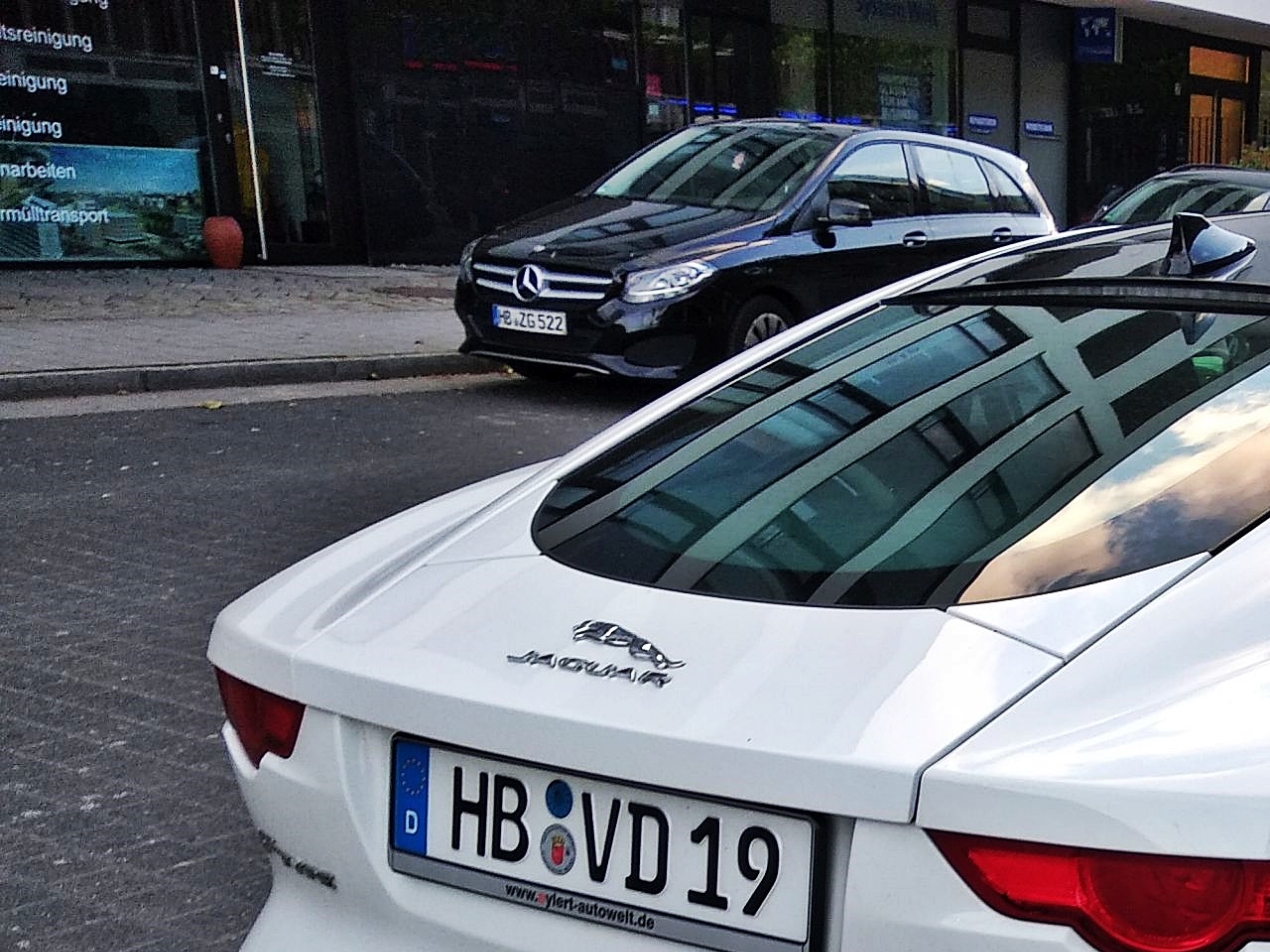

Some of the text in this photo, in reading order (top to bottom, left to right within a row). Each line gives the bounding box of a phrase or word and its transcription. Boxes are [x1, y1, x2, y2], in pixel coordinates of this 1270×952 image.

[0, 24, 93, 52] tsreinigung
[519, 312, 535, 328] ZG
[537, 314, 563, 331] 522
[506, 650, 672, 688] JAGUAR
[404, 809, 418, 835] D
[451, 765, 531, 863] HB
[580, 791, 671, 896] VD
[686, 816, 781, 917] 19
